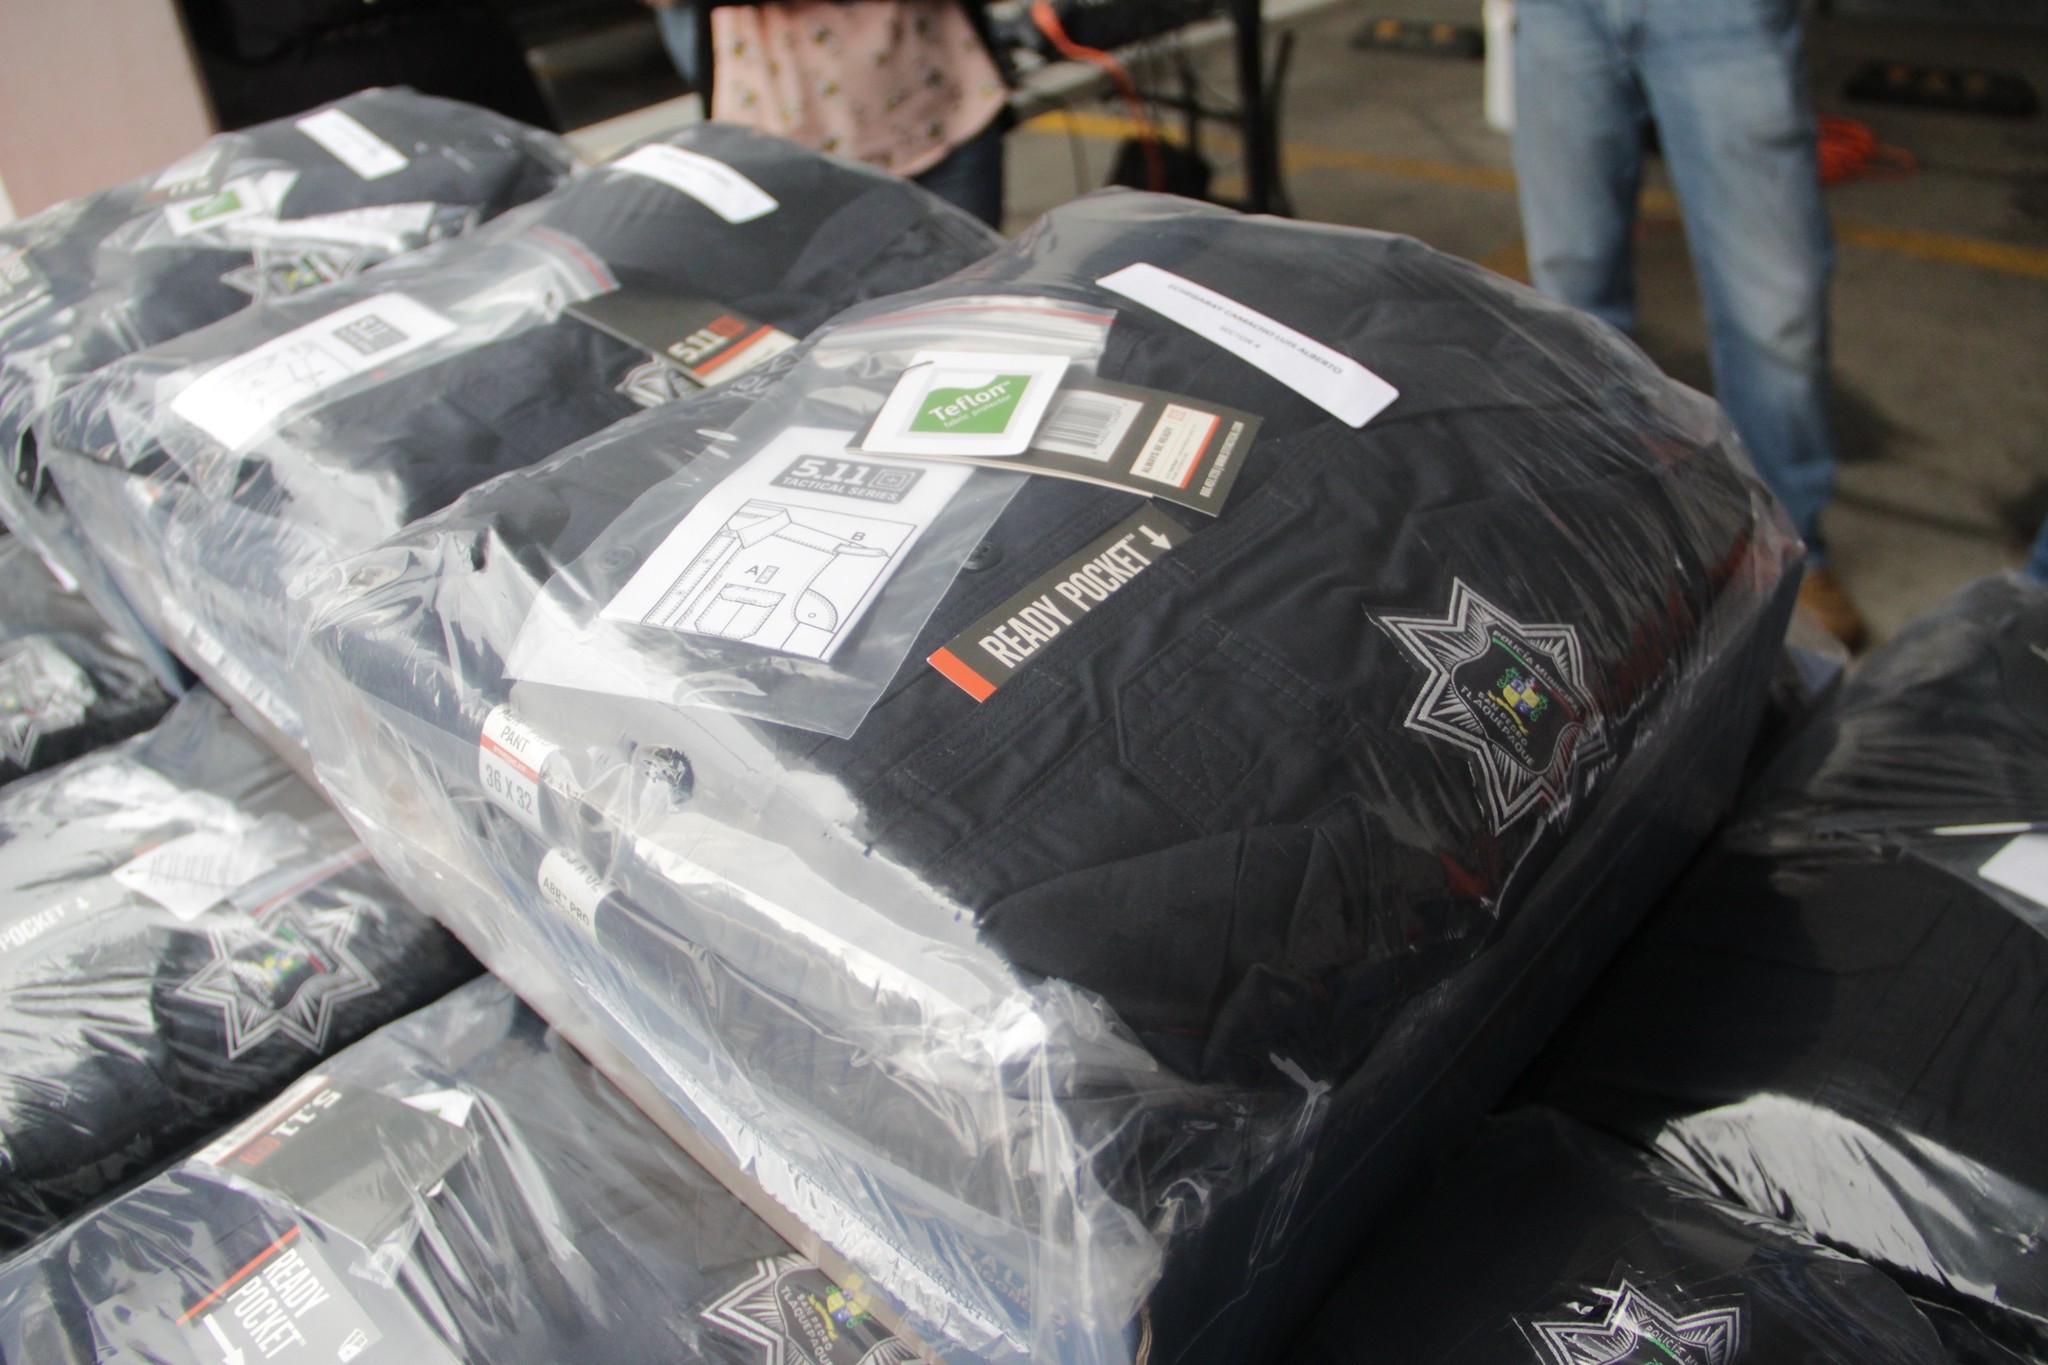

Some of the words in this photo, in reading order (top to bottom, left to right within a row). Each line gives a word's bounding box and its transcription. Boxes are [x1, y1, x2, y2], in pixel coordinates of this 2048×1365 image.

[1224, 308, 1275, 336] CAMACHO
[1297, 347, 1342, 374] ALBERTO
[782, 476, 845, 493] TACTICAL
[848, 486, 899, 501] SERIES
[791, 458, 870, 485] 5.11
[851, 531, 866, 541] B
[744, 565, 759, 575] A
[978, 594, 1073, 669] READY
[500, 725, 531, 753] PANT
[1461, 685, 1535, 766] TLAQUEPAQUE
[1477, 691, 1499, 711] SAN
[1500, 712, 1529, 746] PEDRO
[486, 764, 502, 793] 36
[505, 776, 514, 802] X
[516, 785, 533, 816] 32
[569, 901, 590, 927] PRO
[262, 1247, 330, 1319] READY
[797, 1293, 814, 1315] SAN
[811, 1316, 833, 1351] PEDRO
